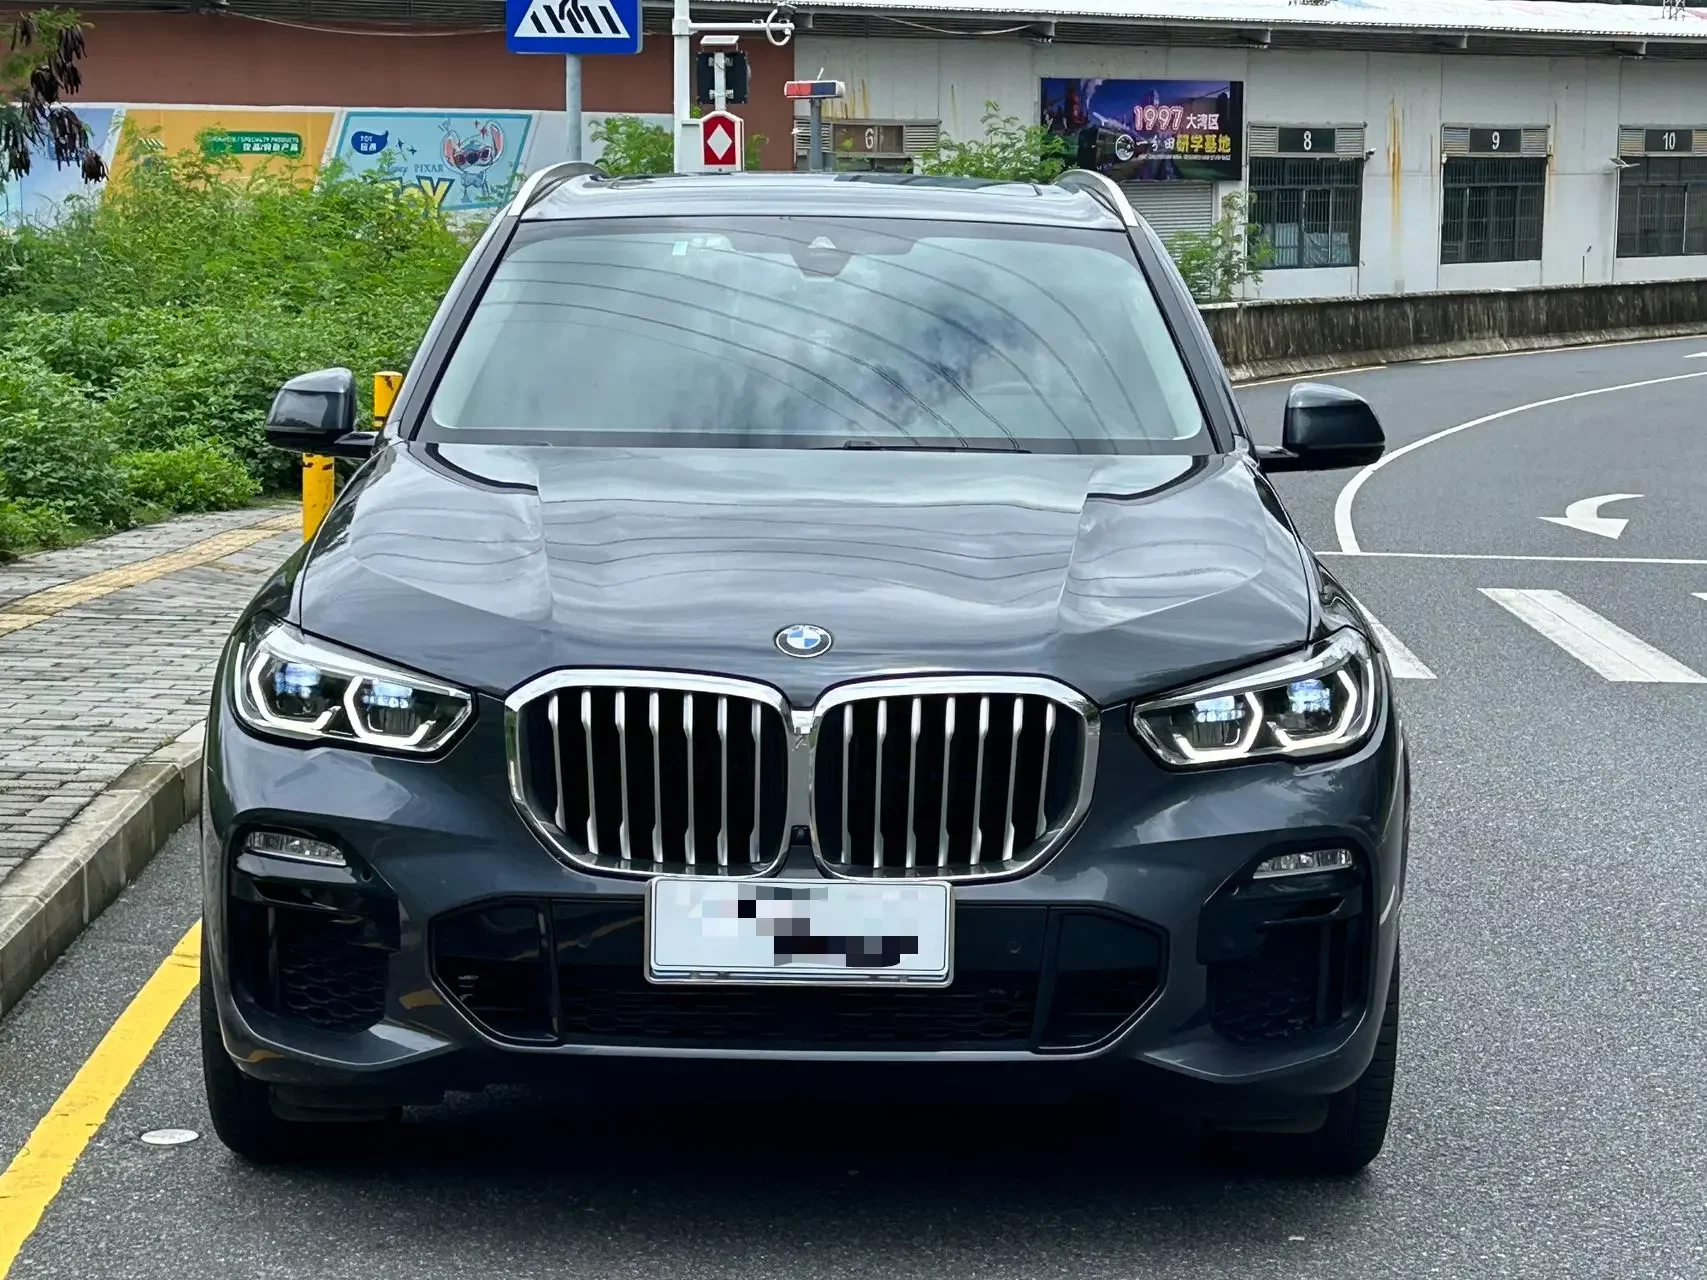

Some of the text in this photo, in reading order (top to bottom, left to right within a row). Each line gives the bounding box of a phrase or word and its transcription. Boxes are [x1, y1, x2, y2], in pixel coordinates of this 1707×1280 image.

[1133, 105, 1220, 131] 1997 大湾区
[865, 128, 874, 149] 6
[1303, 130, 1312, 150] 8
[1492, 131, 1500, 150] 9
[1662, 132, 1676, 150] 10
[414, 164, 444, 173] PIXAR
